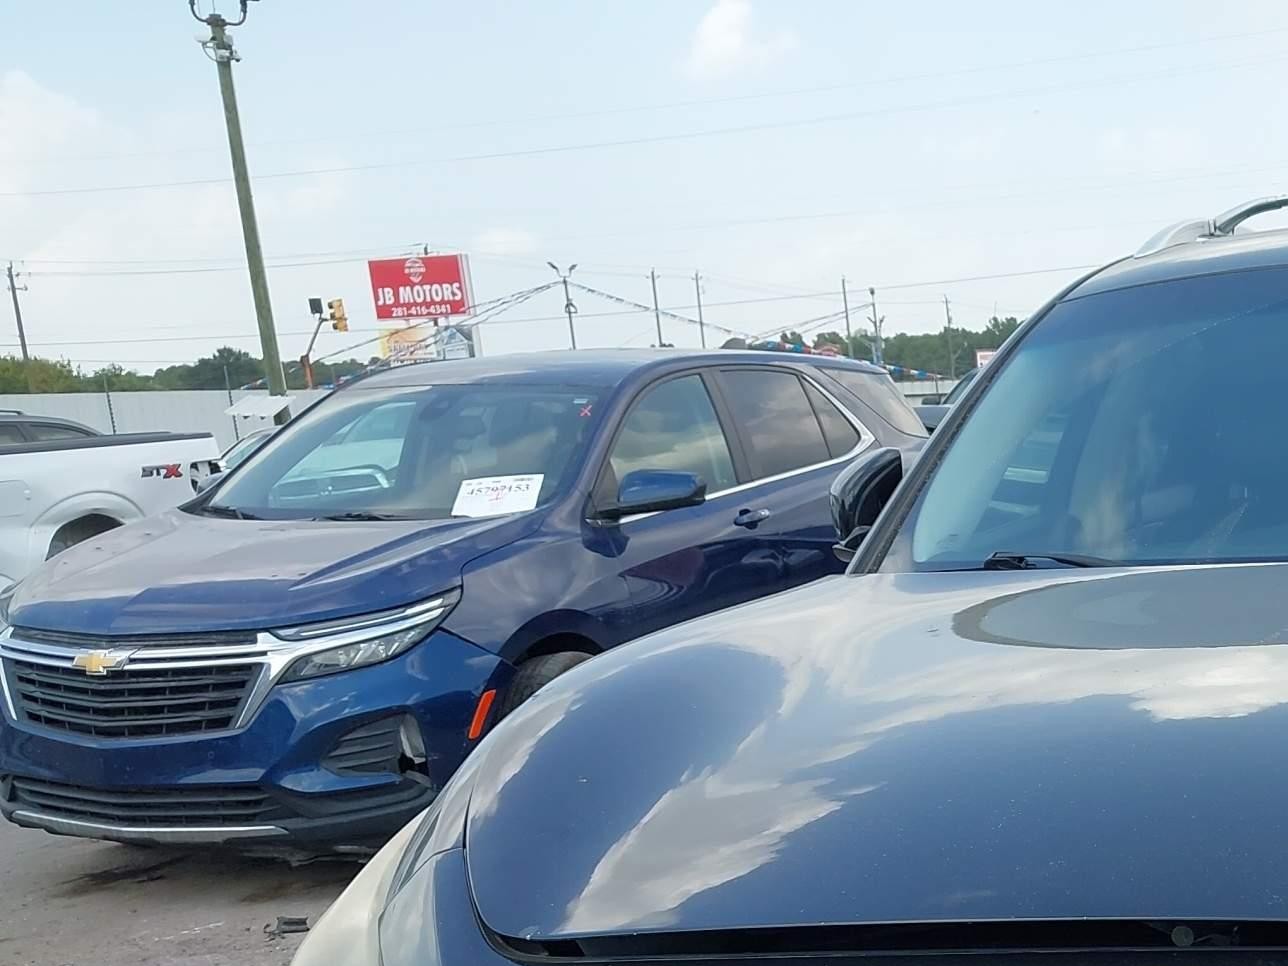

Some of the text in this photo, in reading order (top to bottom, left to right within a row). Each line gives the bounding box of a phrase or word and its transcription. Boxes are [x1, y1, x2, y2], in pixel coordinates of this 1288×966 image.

[377, 282, 462, 306] JB MOTORS
[391, 304, 452, 317] 281-416-4341
[141, 464, 183, 479] STX
